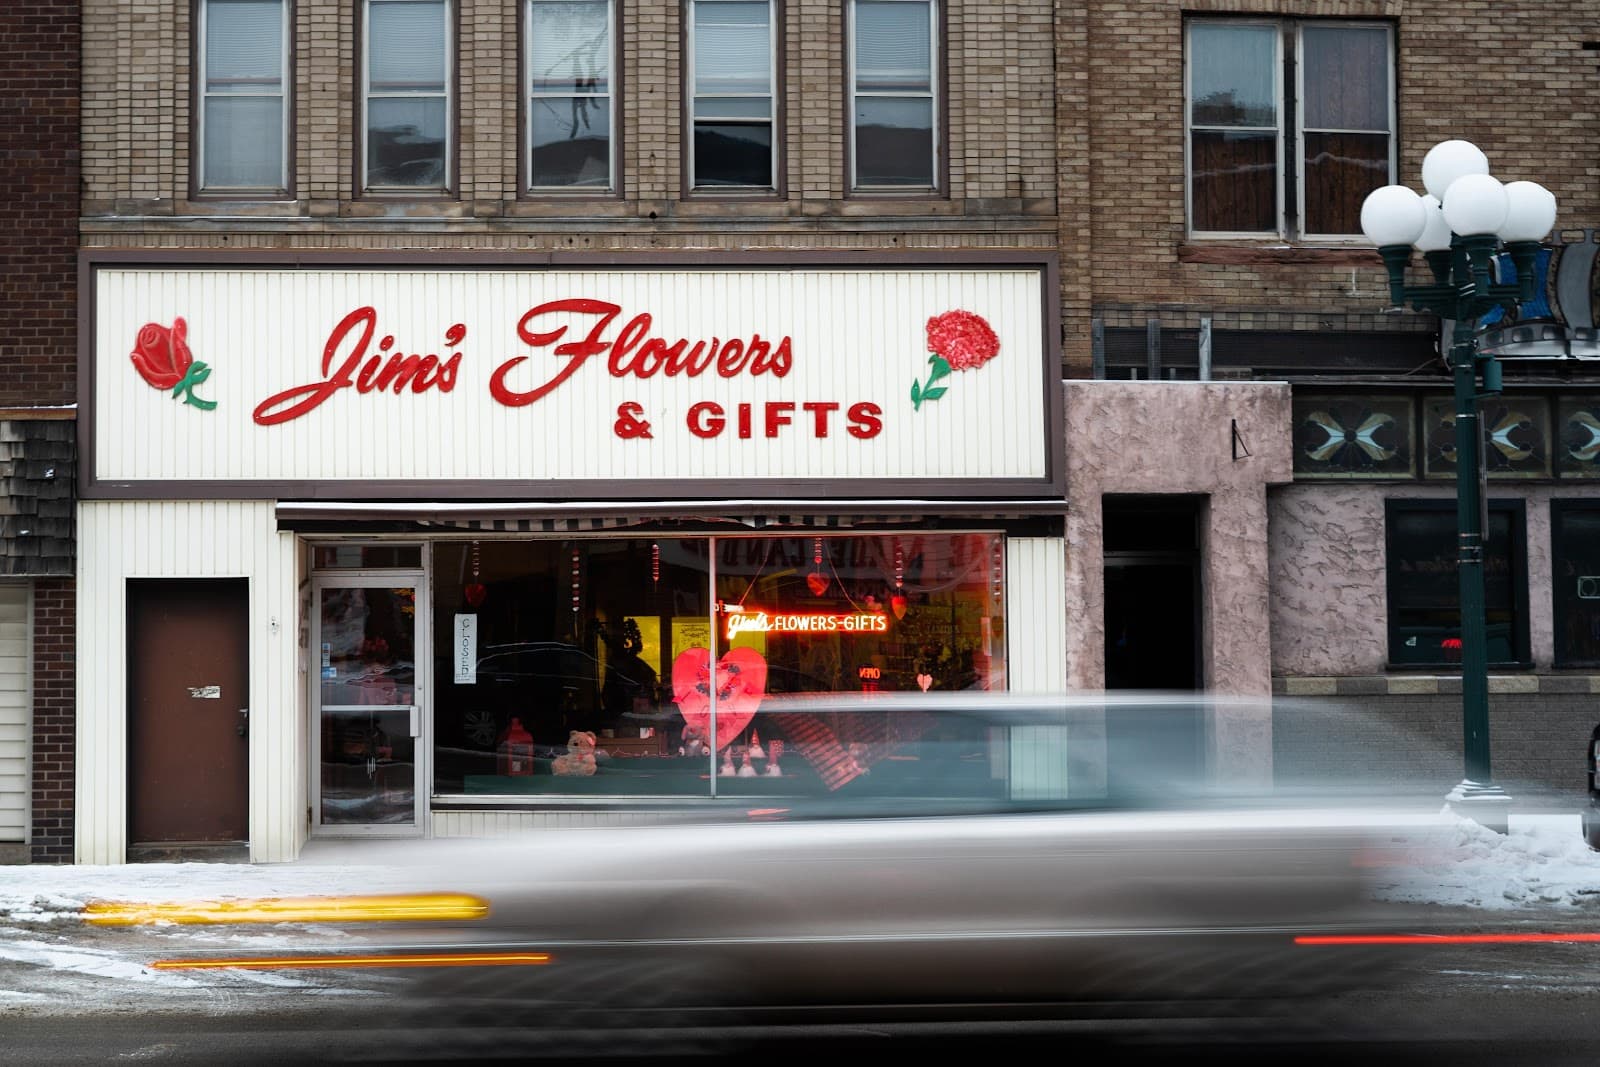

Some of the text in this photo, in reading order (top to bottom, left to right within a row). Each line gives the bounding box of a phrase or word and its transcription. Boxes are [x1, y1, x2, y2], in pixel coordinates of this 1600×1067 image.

[253, 298, 793, 426] Jim's Flowers
[613, 401, 883, 440] & GIFTS
[461, 617, 471, 676] CLOSED
[774, 614, 887, 631] FLOWERS-GIFTS
